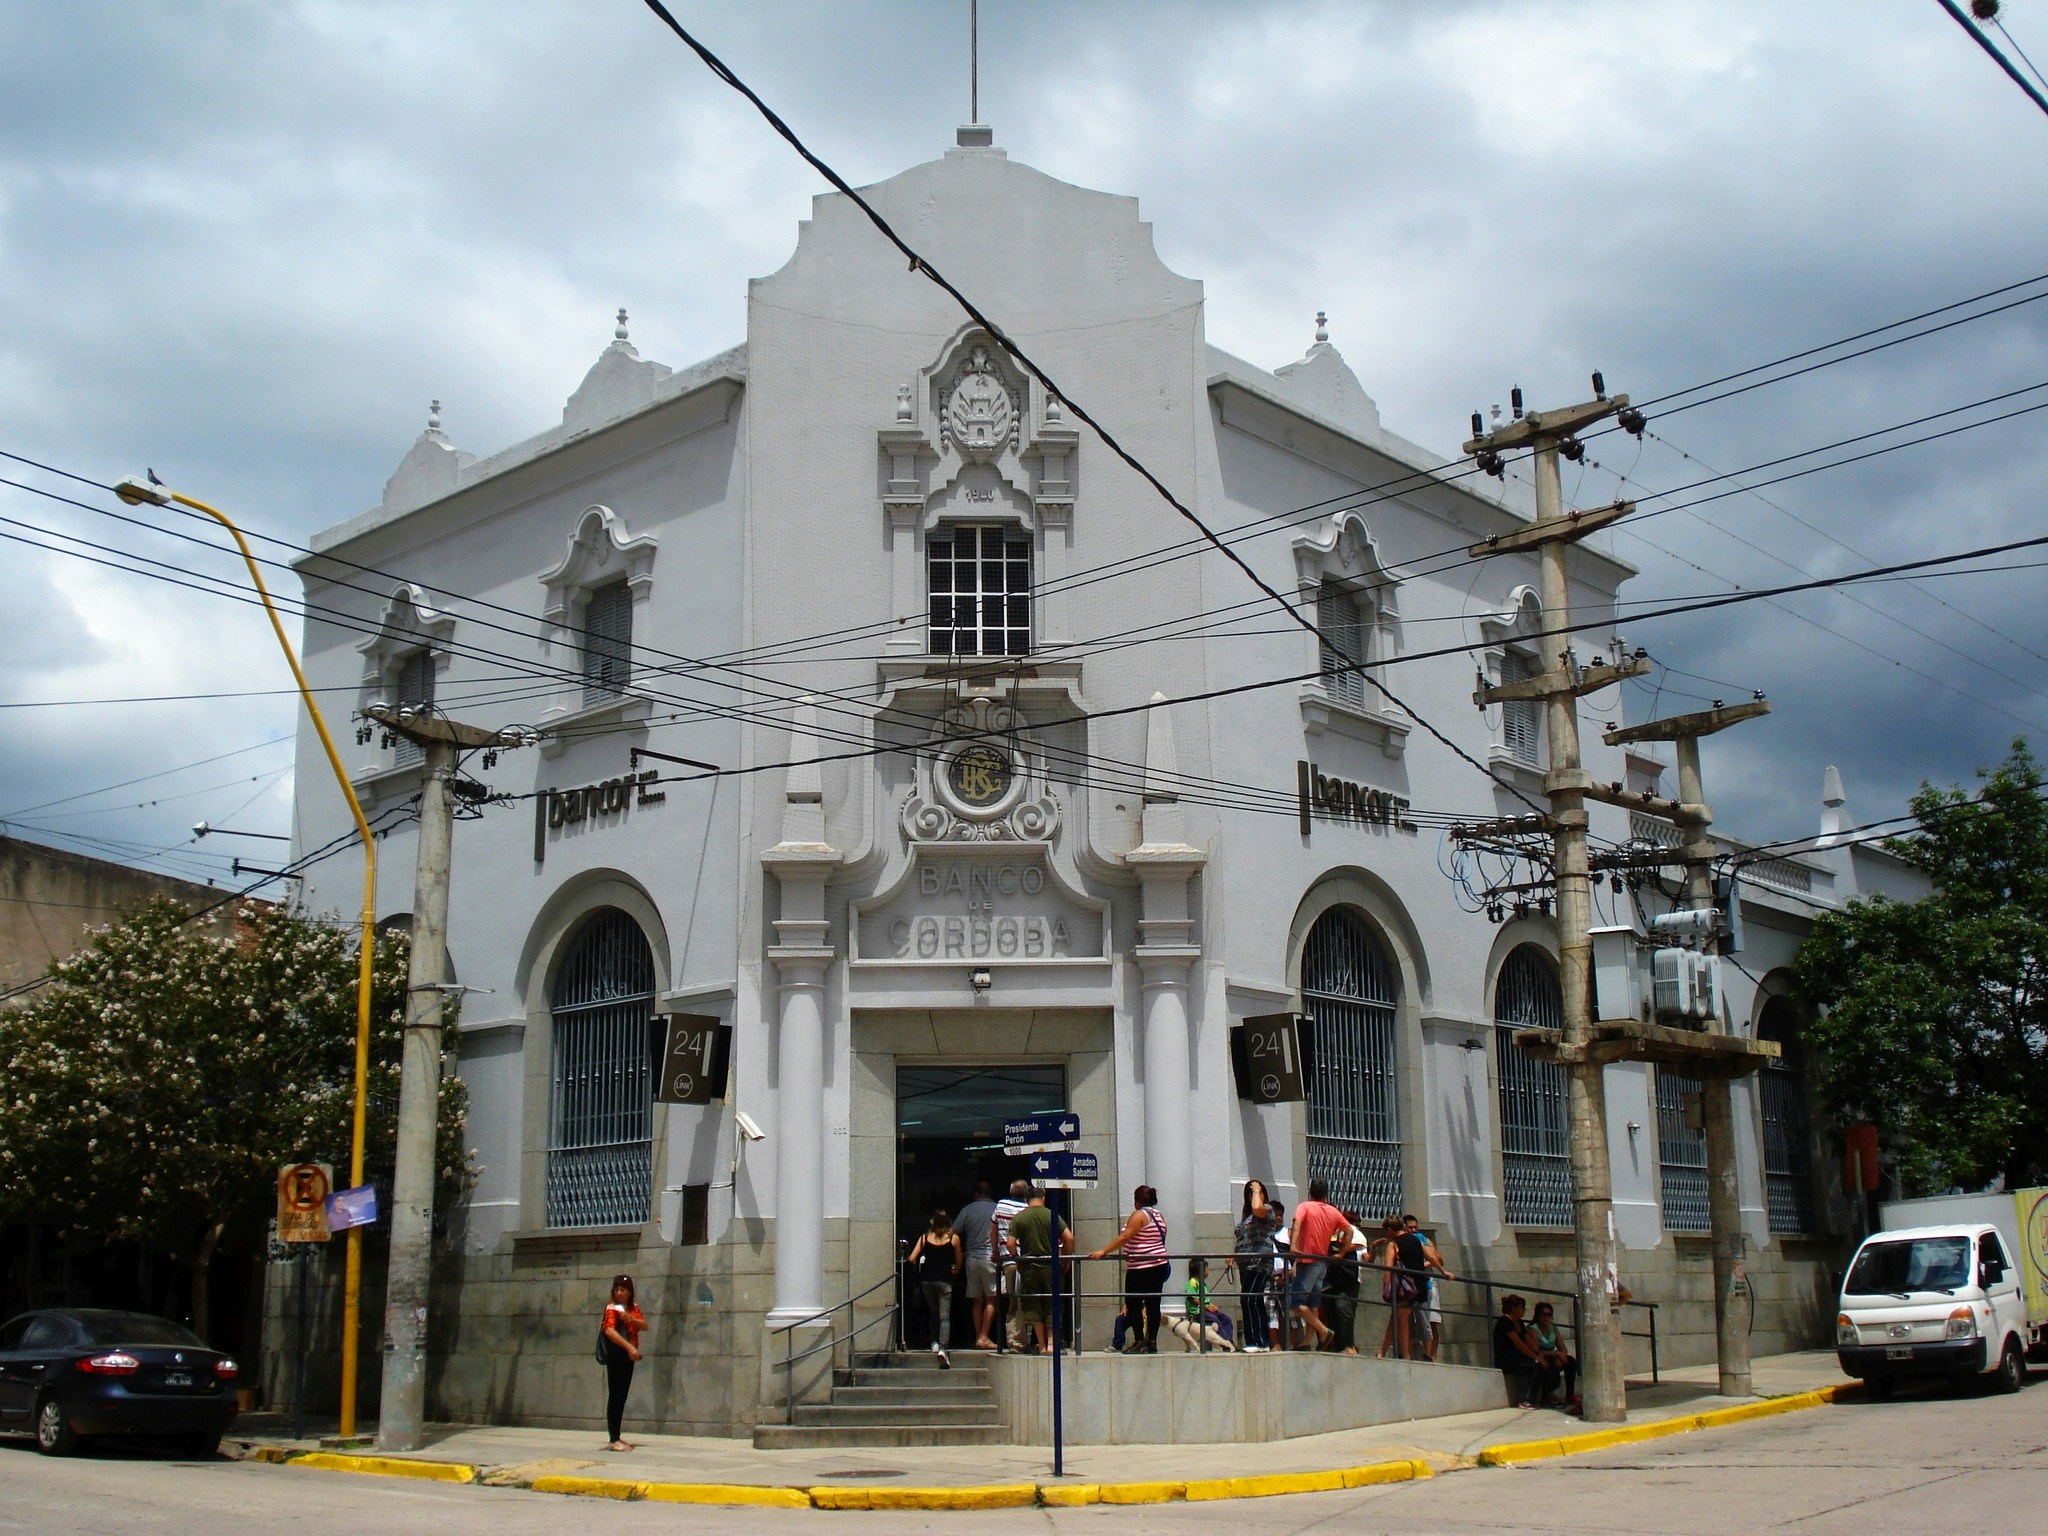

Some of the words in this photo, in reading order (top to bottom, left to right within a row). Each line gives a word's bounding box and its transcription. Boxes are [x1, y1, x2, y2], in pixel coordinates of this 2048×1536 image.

[918, 865, 1045, 897] BANCO
[968, 900, 994, 910] DE
[673, 1030, 702, 1057] 24
[1251, 1031, 1280, 1058] 24
[1004, 1122, 1039, 1134] Presidente
[1005, 1135, 1024, 1144] Perón
[1072, 1157, 1096, 1167] Amadeo
[1072, 1168, 1097, 1177] Sabattini
